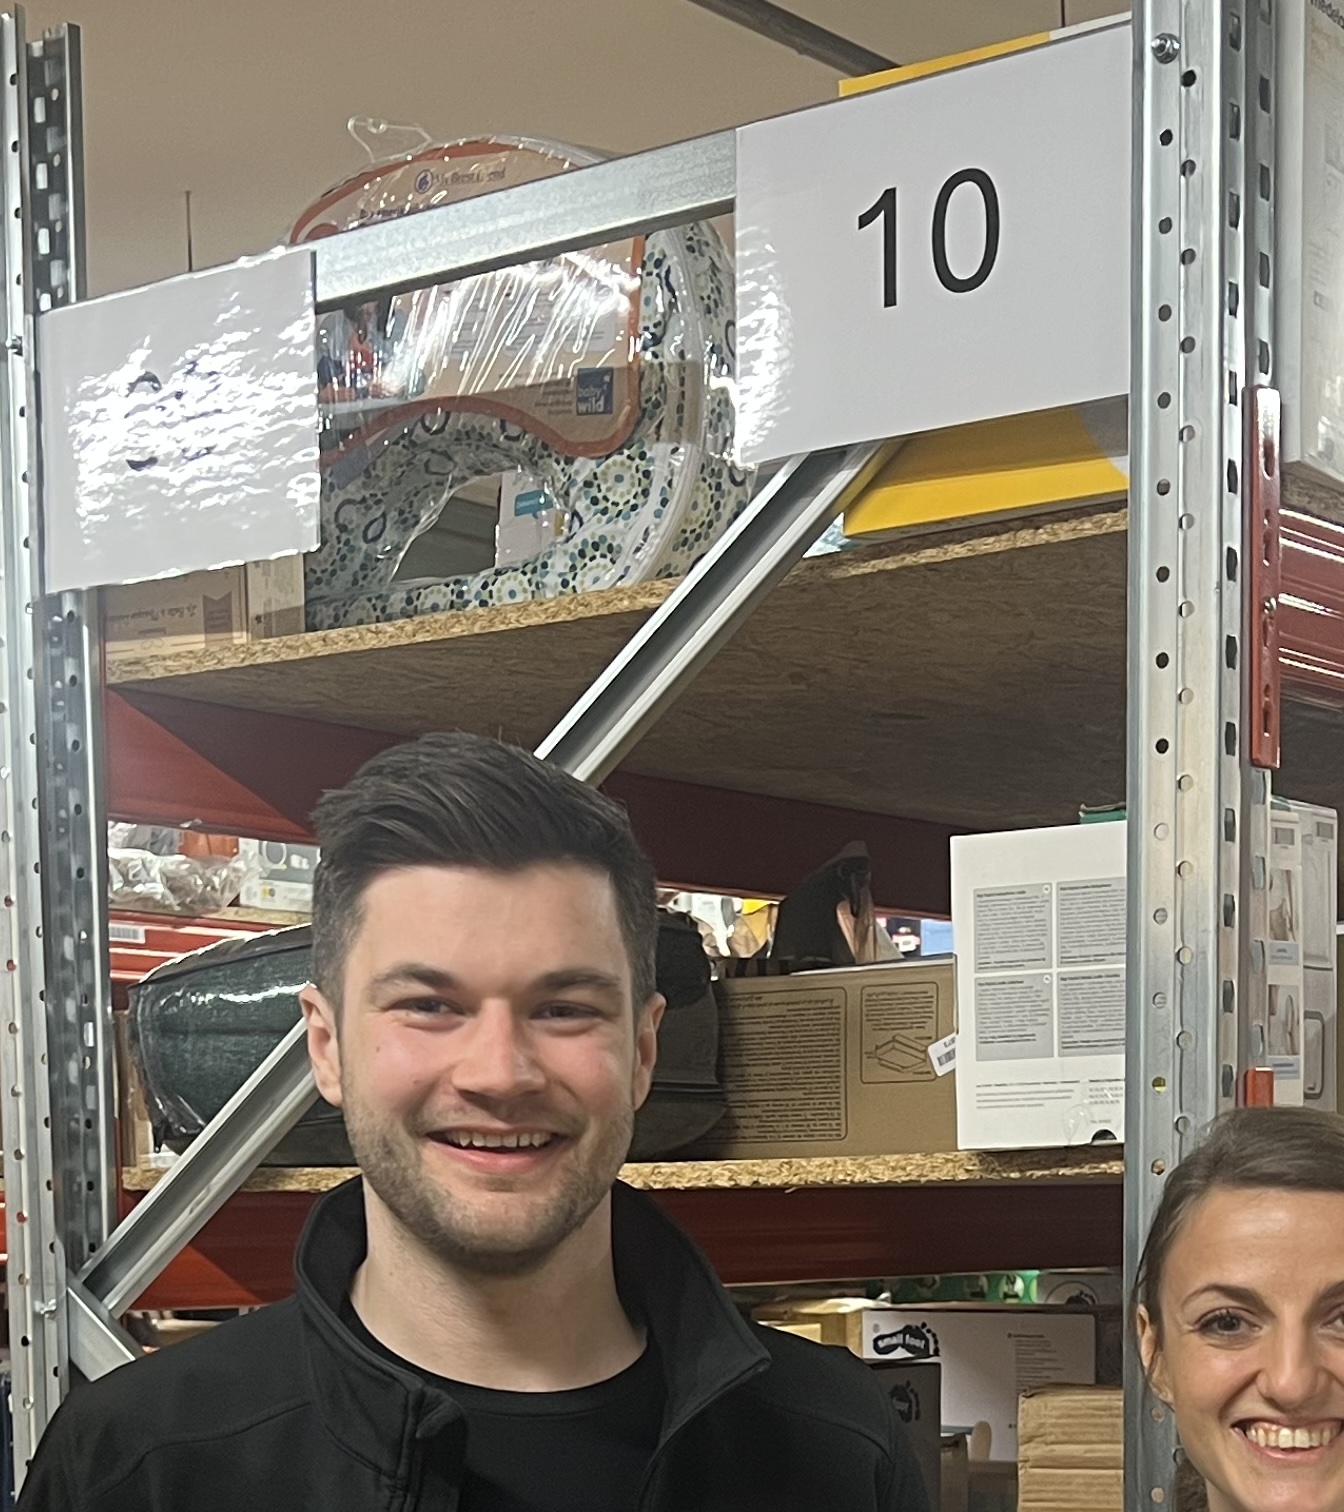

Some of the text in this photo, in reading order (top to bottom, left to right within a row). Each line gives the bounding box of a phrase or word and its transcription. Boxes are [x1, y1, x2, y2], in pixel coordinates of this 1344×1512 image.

[855, 166, 1002, 310] 10
[578, 395, 605, 413] wild
[877, 1333, 903, 1348] small
